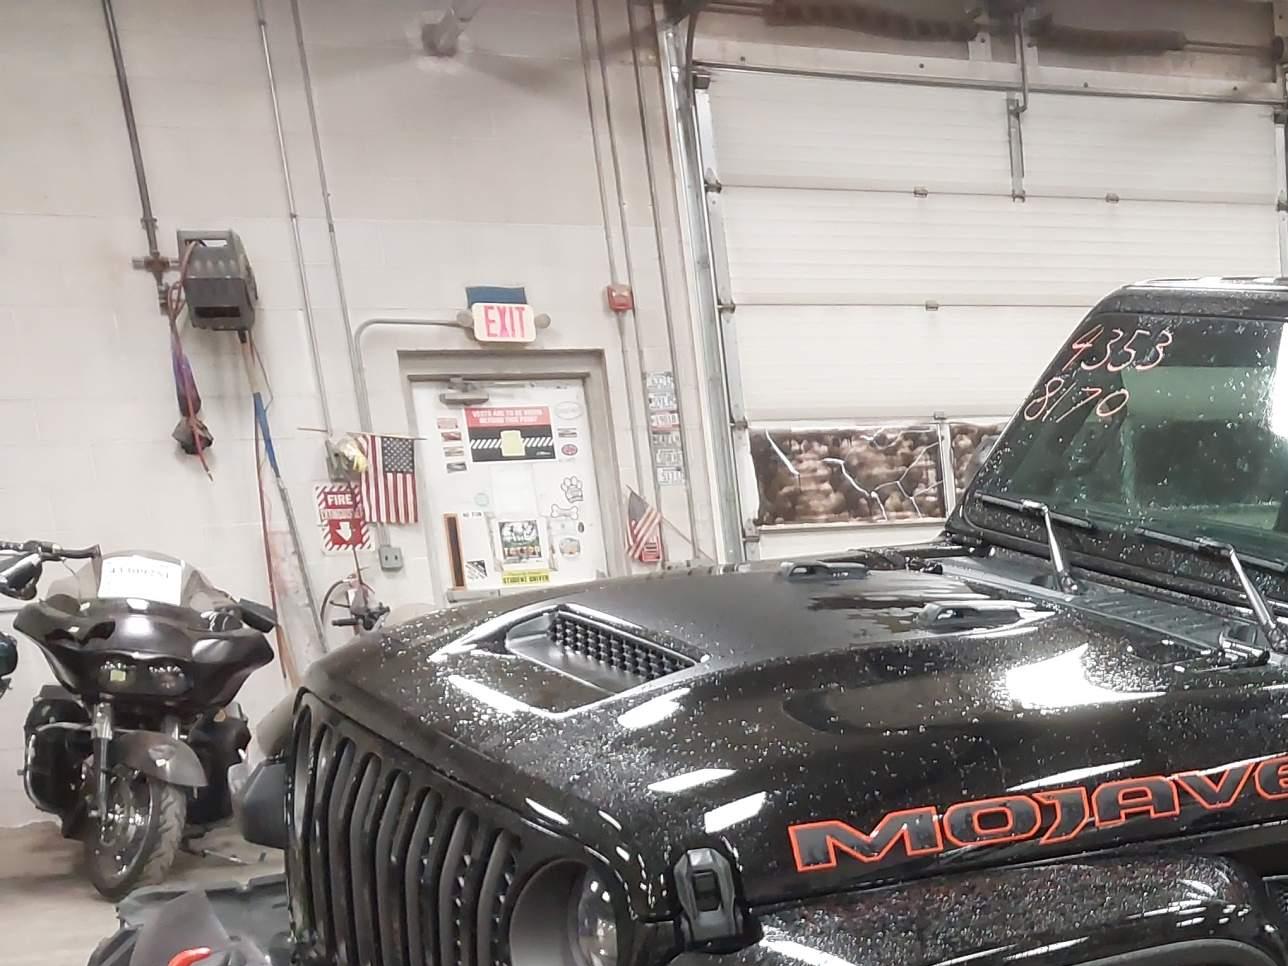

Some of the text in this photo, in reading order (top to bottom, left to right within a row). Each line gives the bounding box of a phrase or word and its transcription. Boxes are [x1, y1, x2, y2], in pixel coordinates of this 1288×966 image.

[483, 305, 526, 338] EXIT
[1061, 324, 1173, 372] 4353
[1024, 377, 1130, 423] 8170
[327, 493, 353, 506] FIRE
[503, 574, 549, 584] STUDENT DRIVER
